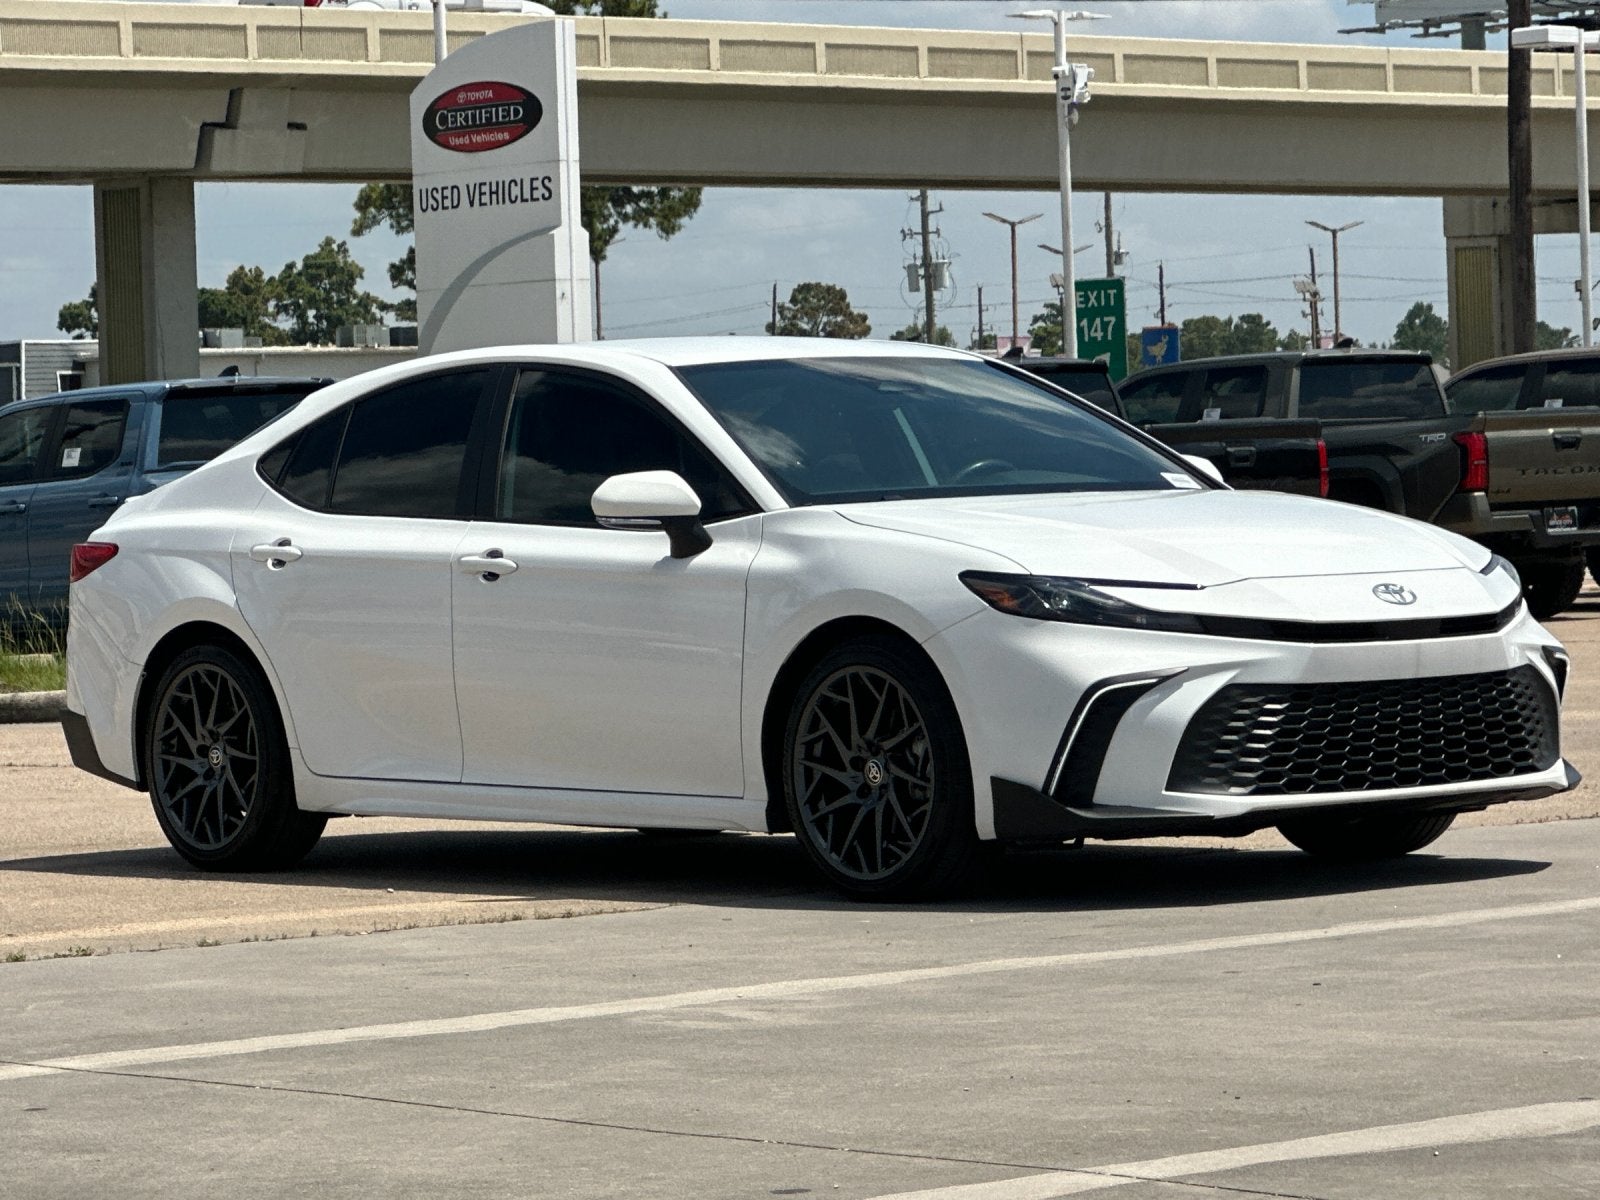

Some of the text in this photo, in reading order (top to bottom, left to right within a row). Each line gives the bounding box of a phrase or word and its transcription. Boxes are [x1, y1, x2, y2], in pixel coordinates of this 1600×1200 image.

[467, 90, 493, 100] TOYOTA
[436, 106, 523, 129] CERTIFIED
[449, 132, 510, 145] Used Vehicles
[419, 176, 552, 212] USED VEHICLES
[1076, 289, 1117, 308] EXIT
[1080, 316, 1116, 342] 147
[1419, 432, 1446, 442] TRD
